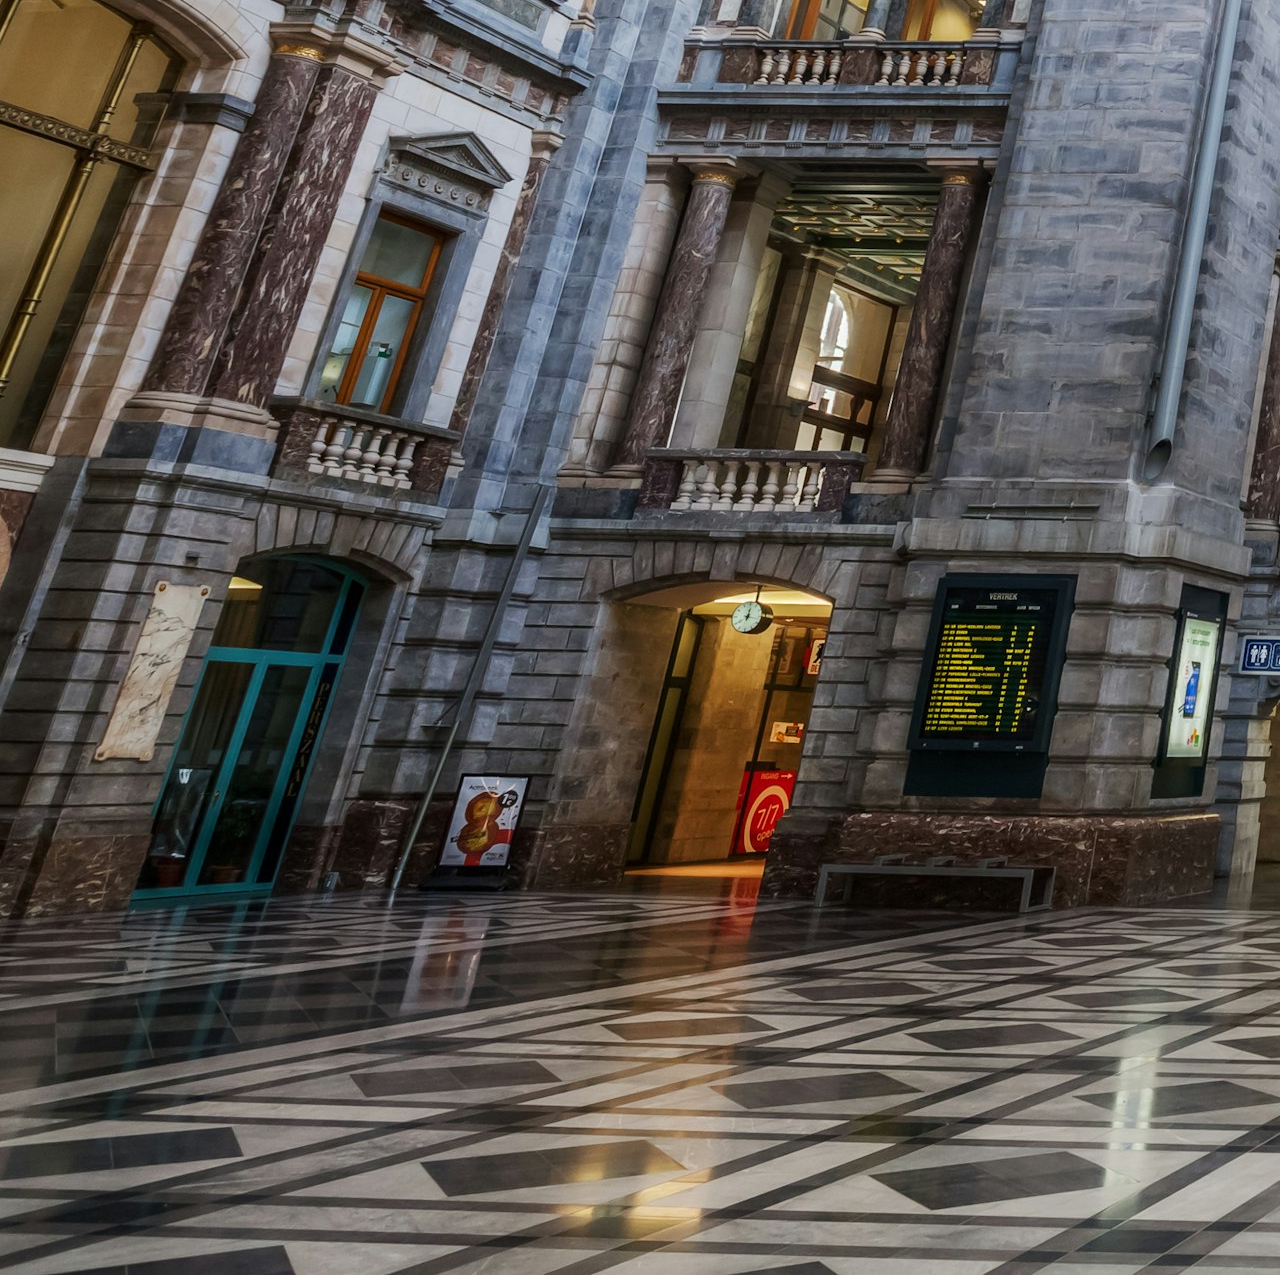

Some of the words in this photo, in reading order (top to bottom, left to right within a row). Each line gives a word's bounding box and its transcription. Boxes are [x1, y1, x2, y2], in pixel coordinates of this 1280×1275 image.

[989, 592, 1018, 601] VERTREK
[287, 682, 330, 797] PERSZAAL
[757, 804, 780, 830] 7/7
